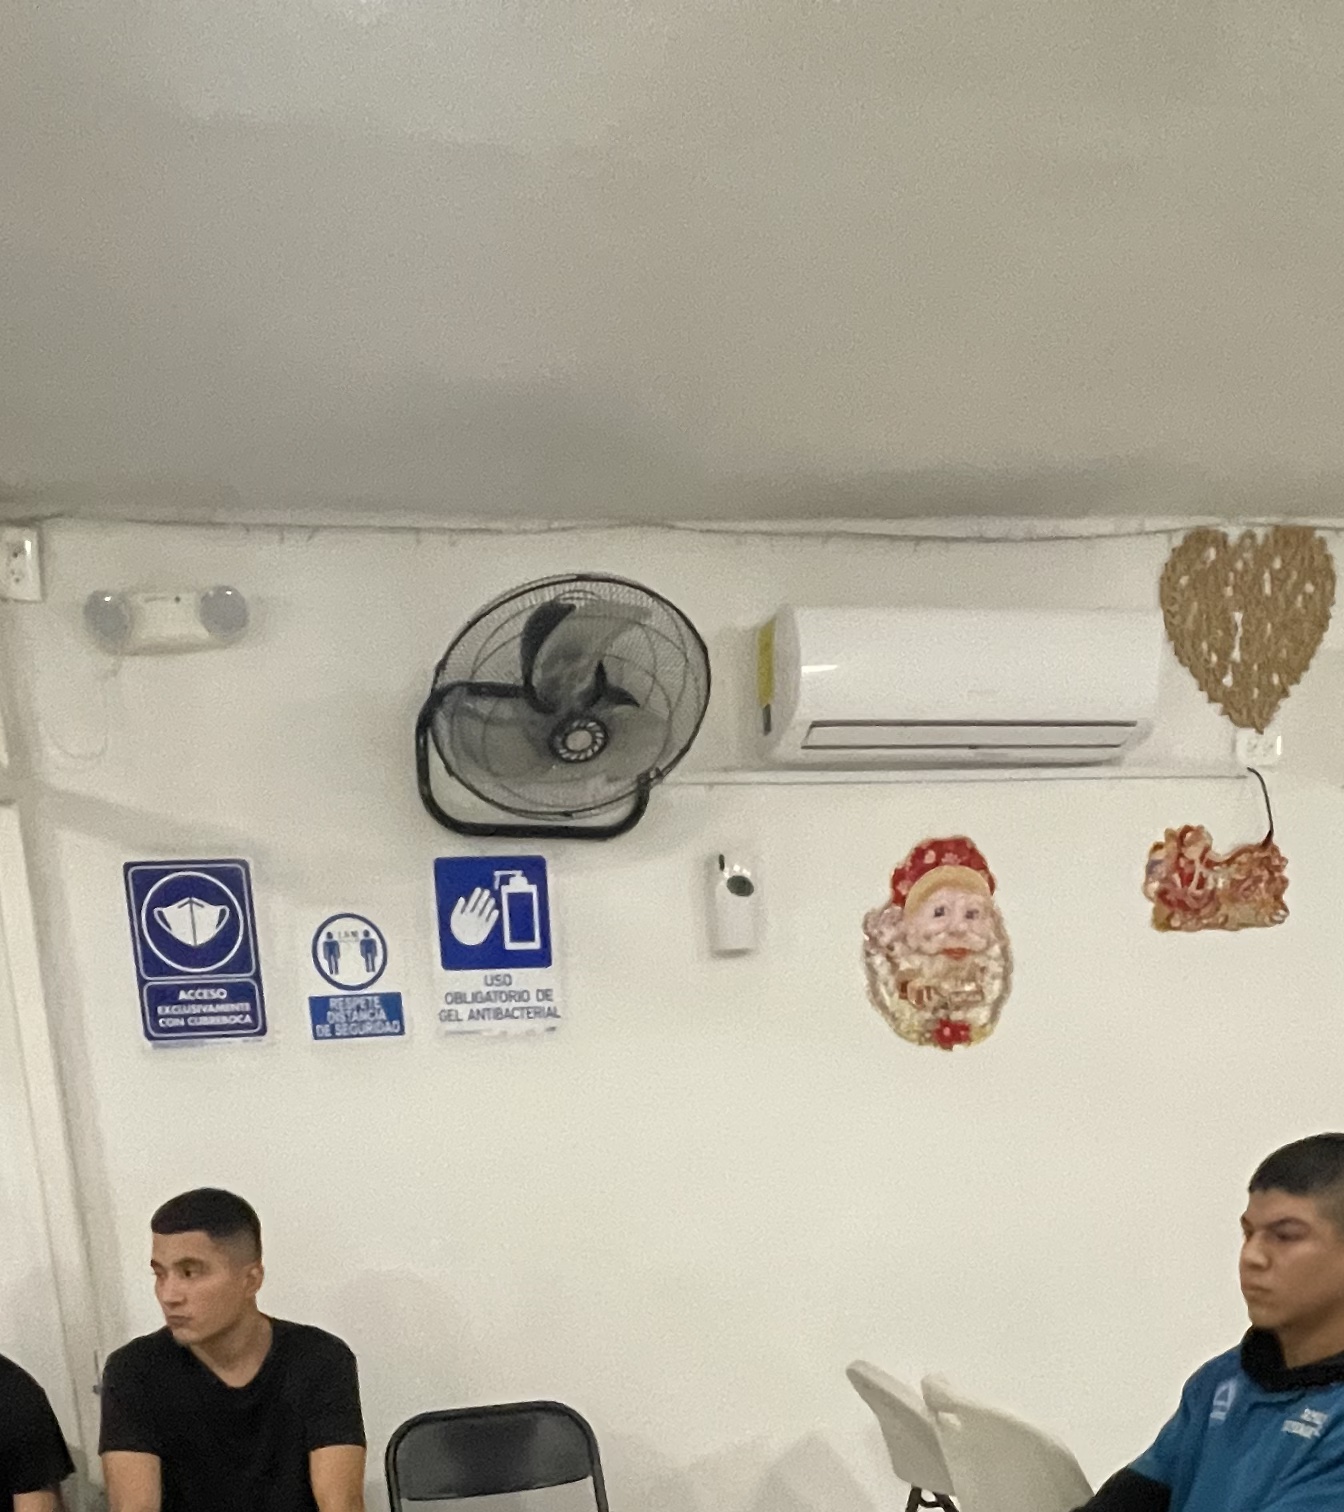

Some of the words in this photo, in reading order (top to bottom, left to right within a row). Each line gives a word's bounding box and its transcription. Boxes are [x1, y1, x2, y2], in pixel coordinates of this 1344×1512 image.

[484, 974, 512, 986] USO
[178, 988, 228, 1000] ACCESO
[444, 990, 531, 1005] OBLIGATORIO
[536, 989, 553, 1002] DE
[157, 1002, 251, 1015] EXCLUSIVAMENTE
[438, 1009, 463, 1022] GEL
[468, 1006, 561, 1021] ANTIBACTERIAL
[158, 1018, 185, 1027] CON
[187, 1014, 252, 1026] CUBREBOCA
[326, 1008, 387, 1024] DISTANCIA
[316, 1024, 332, 1037] DE
[334, 1020, 400, 1036] SEGURIDAD
